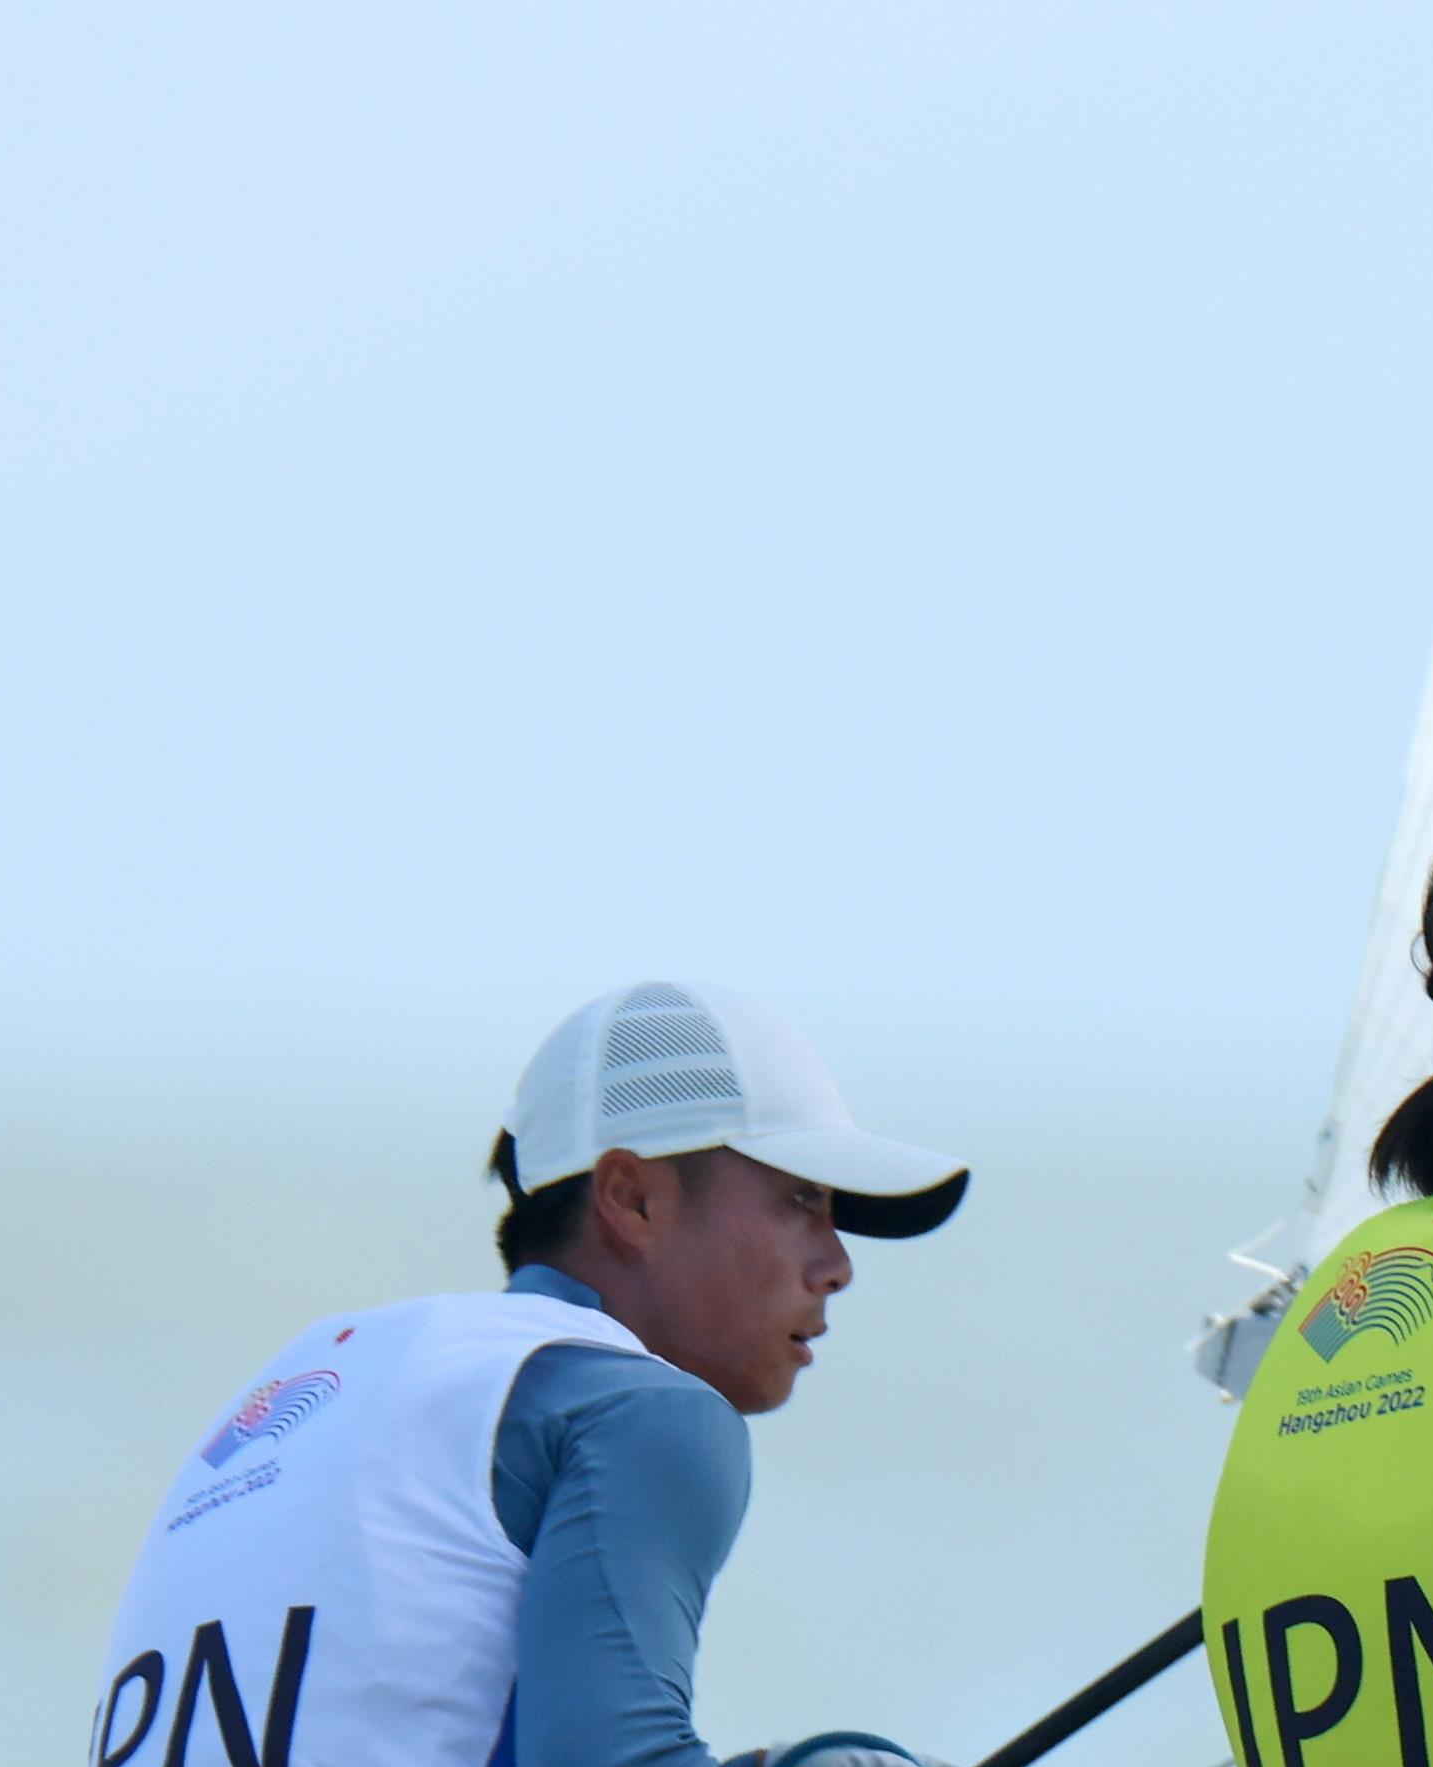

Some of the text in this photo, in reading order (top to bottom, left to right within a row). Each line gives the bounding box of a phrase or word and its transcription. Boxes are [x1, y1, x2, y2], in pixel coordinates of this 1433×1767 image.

[1326, 1380, 1363, 1399] Asian
[1365, 1368, 1413, 1391] Games
[1278, 1385, 1426, 1438] Hangzhou 2022
